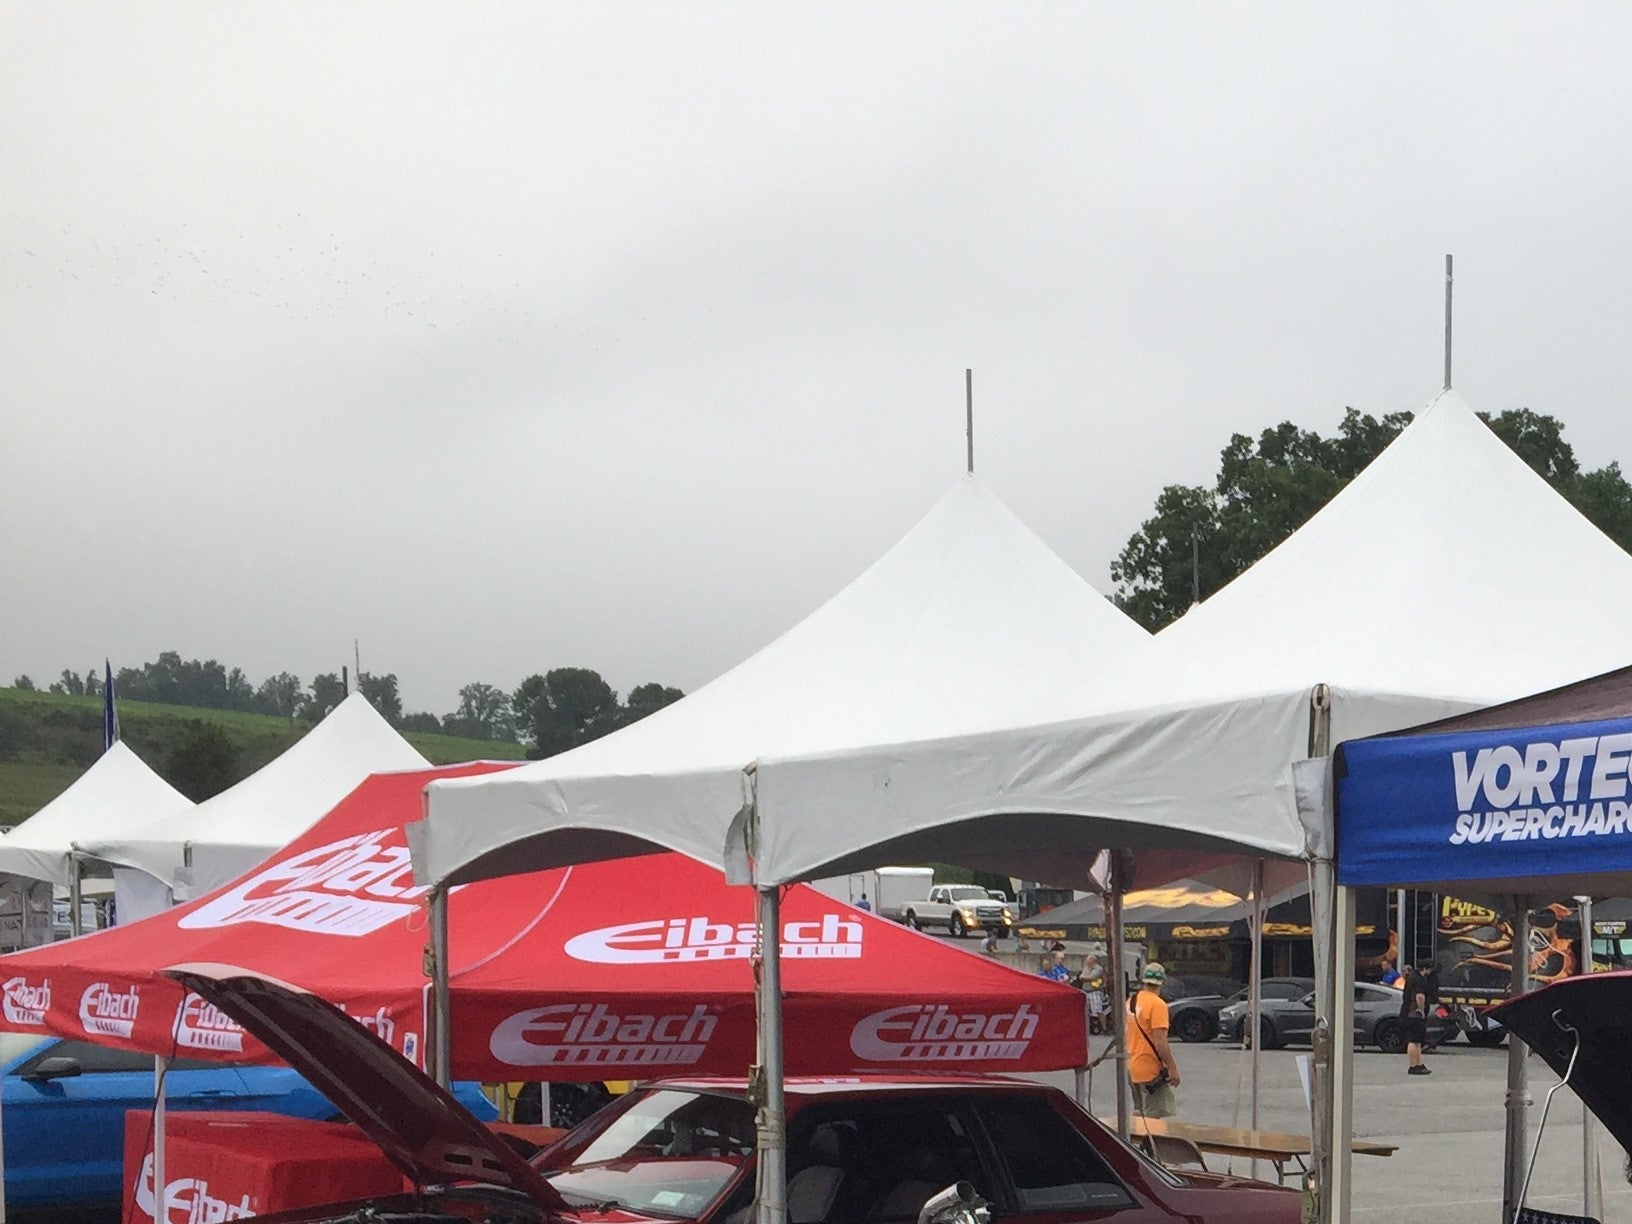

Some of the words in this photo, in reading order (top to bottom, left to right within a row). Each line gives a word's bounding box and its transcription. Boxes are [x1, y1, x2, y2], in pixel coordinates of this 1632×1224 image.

[79, 982, 139, 1039] Eibach
[489, 1004, 721, 1067] Eibach
[850, 1004, 1040, 1061] Eibach
